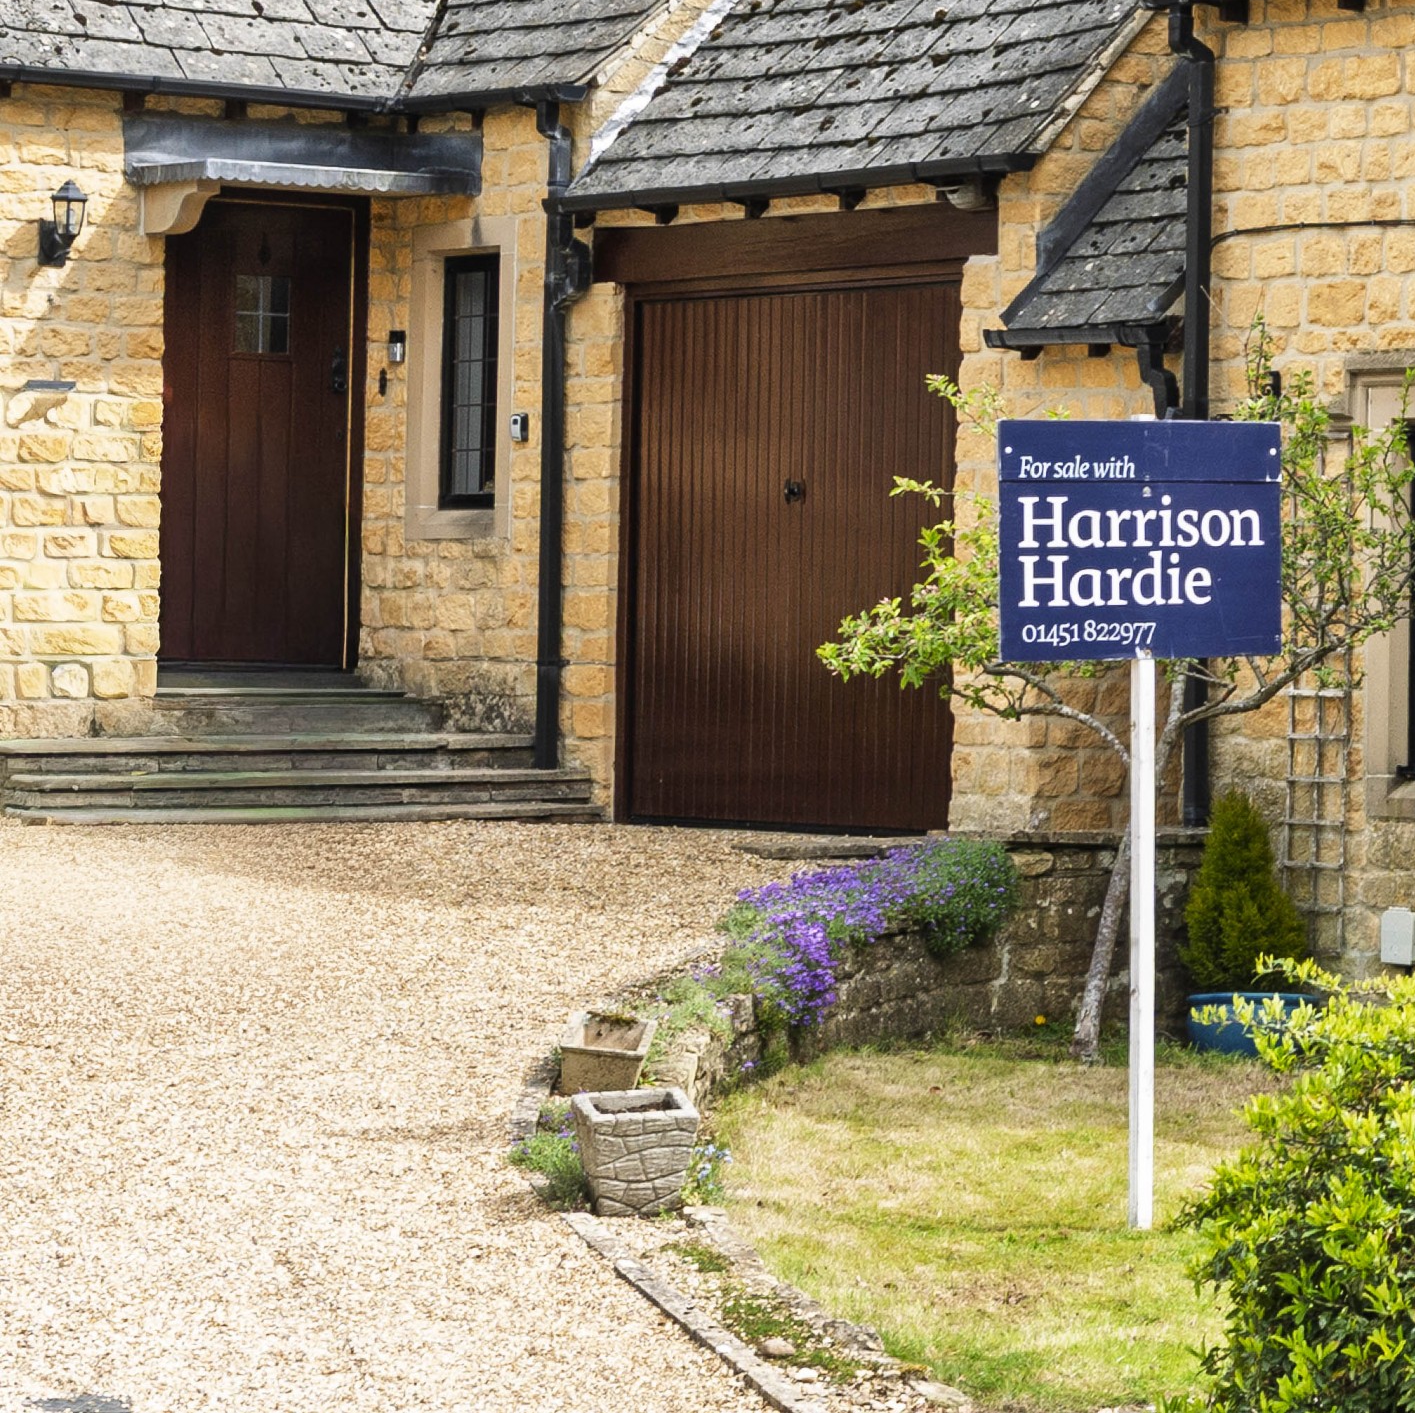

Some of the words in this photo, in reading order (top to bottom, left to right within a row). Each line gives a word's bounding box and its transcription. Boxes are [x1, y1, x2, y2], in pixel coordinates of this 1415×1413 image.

[1019, 456, 1051, 478] For
[1053, 455, 1089, 479] sale
[1093, 456, 1136, 479] with
[1017, 494, 1265, 548] Harrison
[1017, 550, 1212, 607] Hardie
[1021, 622, 1080, 646] 01451
[1083, 619, 1156, 645] 822977
